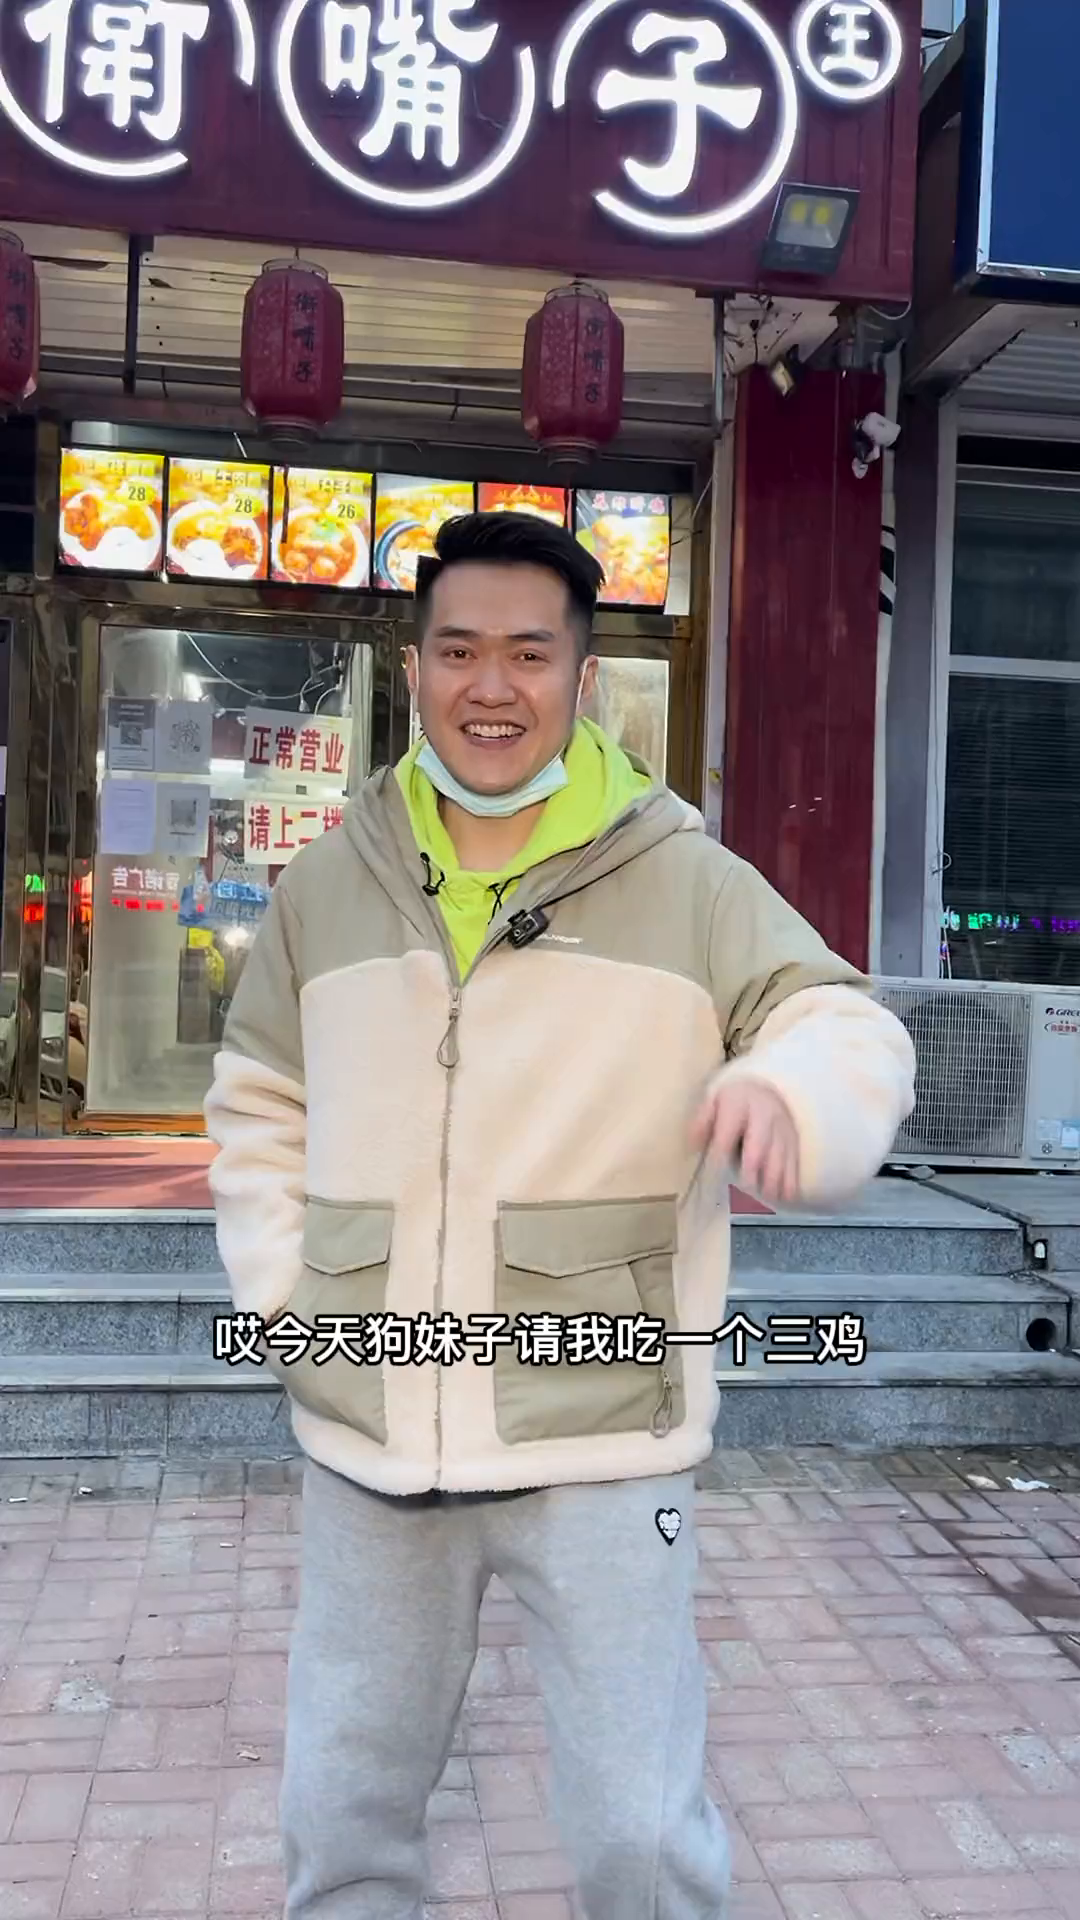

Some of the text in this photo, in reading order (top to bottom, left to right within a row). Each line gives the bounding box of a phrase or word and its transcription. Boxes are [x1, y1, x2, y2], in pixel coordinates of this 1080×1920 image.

[128, 486, 146, 501] 28
[235, 498, 252, 513] 28
[338, 504, 356, 519] 26
[248, 726, 345, 774] 正常营业
